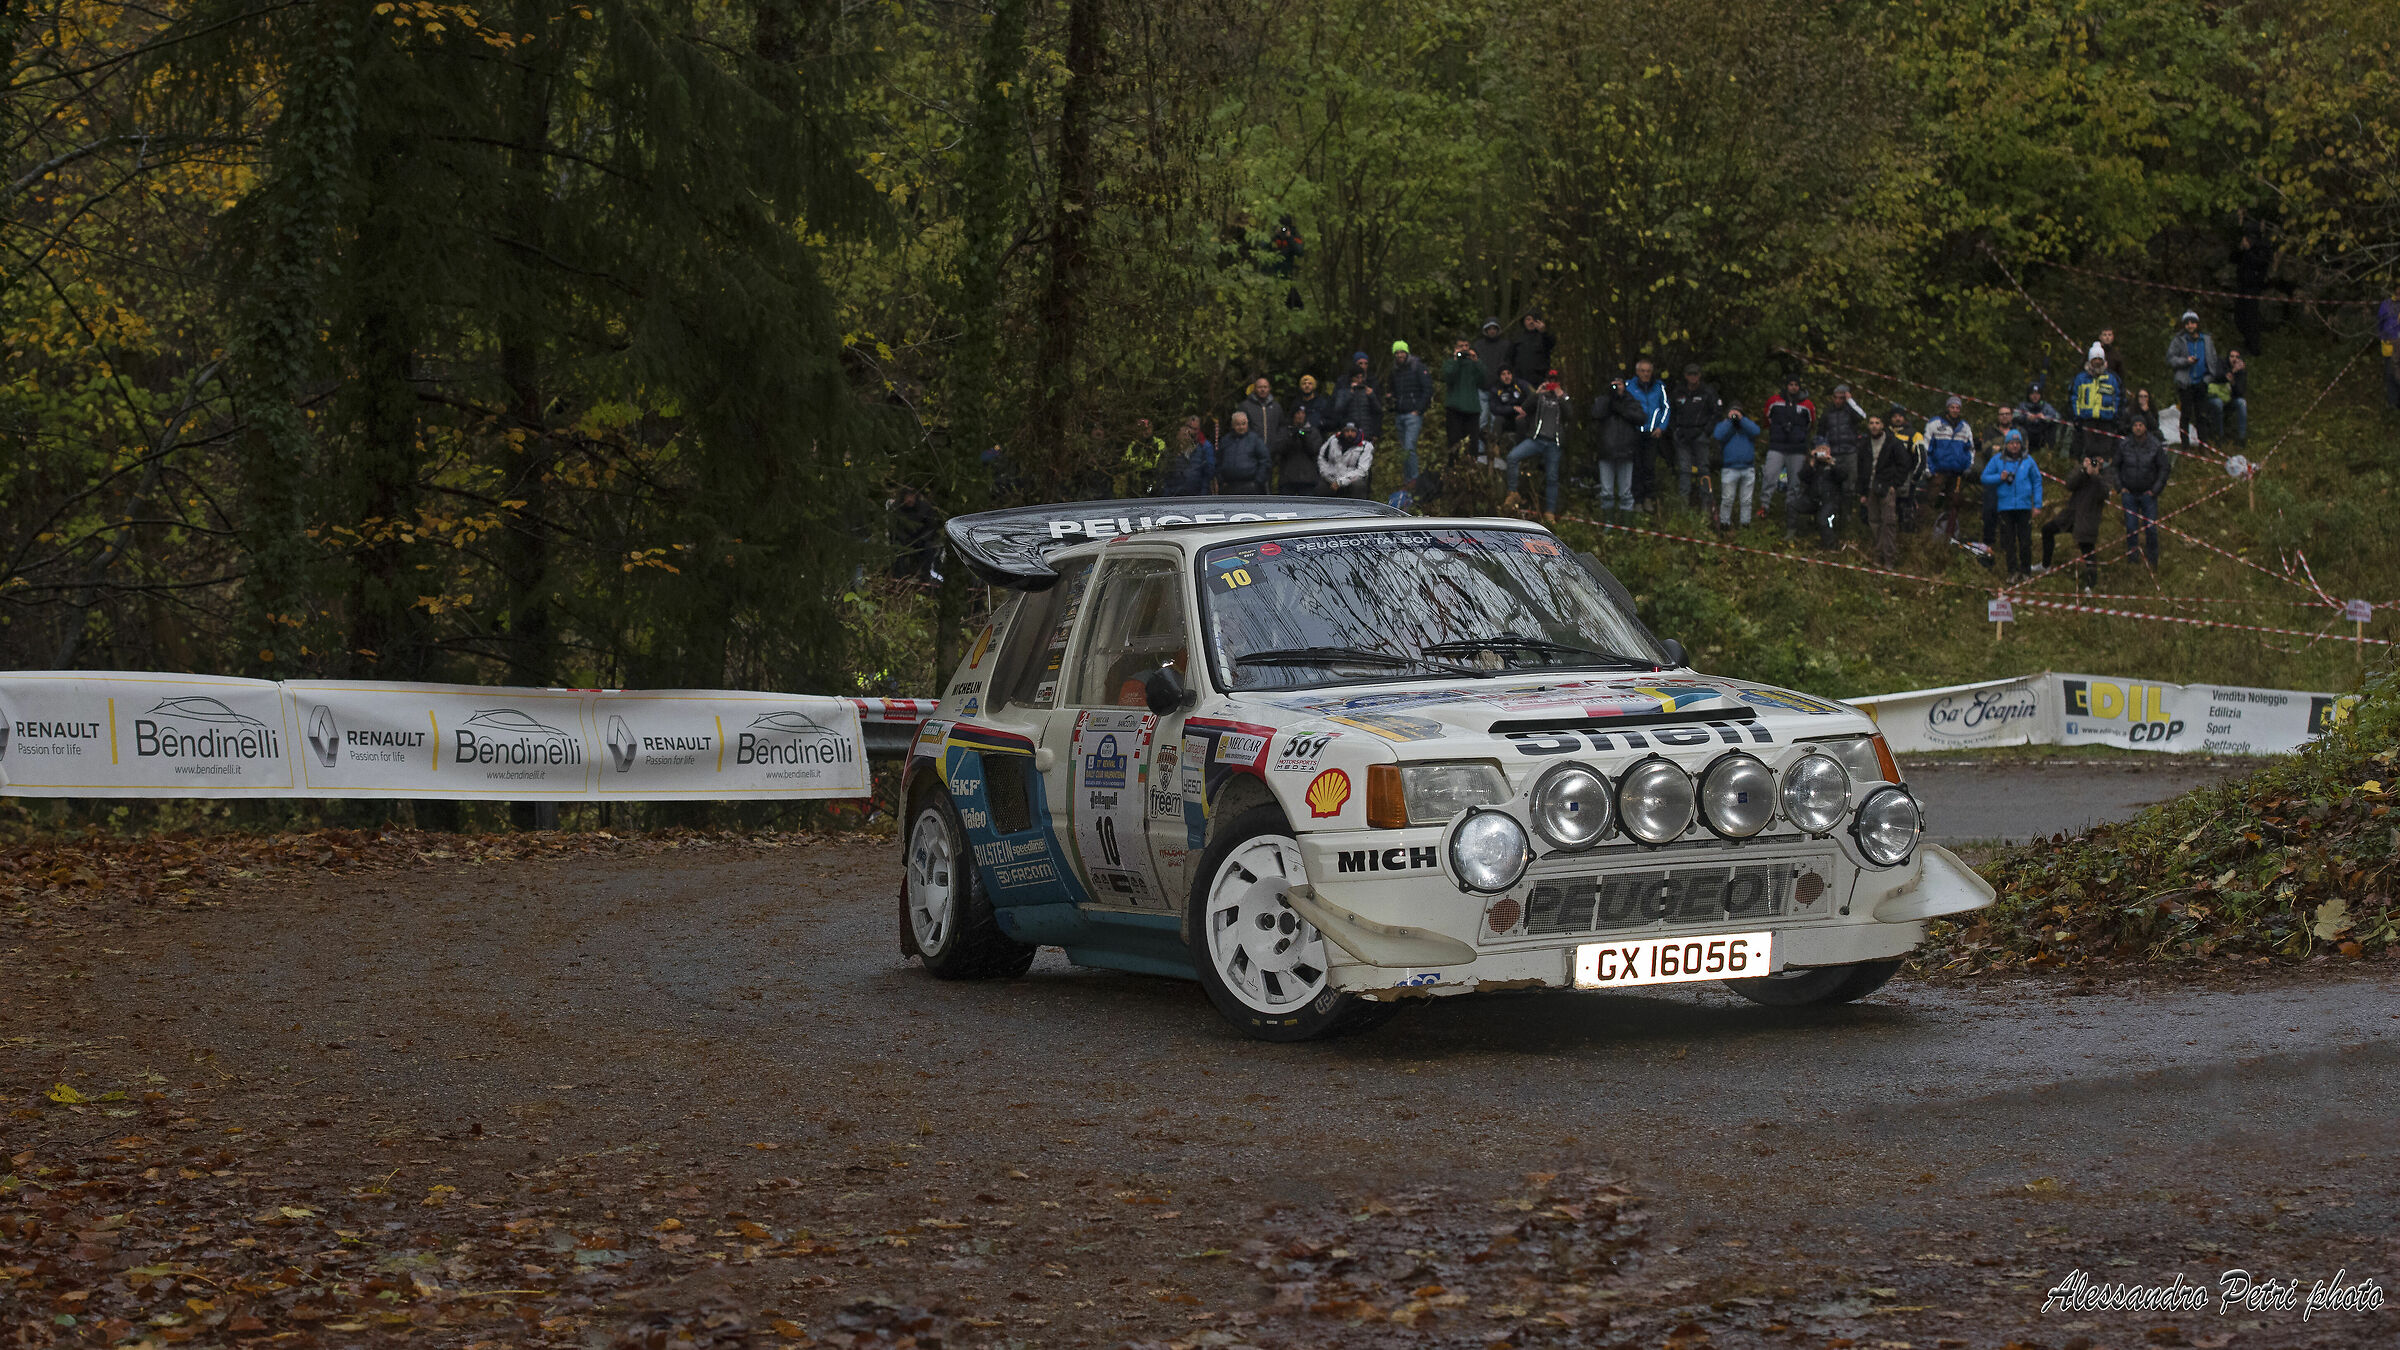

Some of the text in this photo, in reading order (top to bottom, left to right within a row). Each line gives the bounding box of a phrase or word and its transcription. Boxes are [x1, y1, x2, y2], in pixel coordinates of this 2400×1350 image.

[1296, 538, 1369, 552] PEUGEOT
[1220, 568, 1252, 589] 10
[951, 681, 982, 697] MICHELIN
[2063, 680, 2170, 723] EDIL
[2212, 690, 2288, 706] Vendita Noleggio
[2209, 706, 2242, 718] Edilizia
[16, 721, 100, 739] RENAULT
[2129, 720, 2184, 742] CDP
[2206, 722, 2231, 734] Sport
[135, 719, 280, 759] Bendinelli
[347, 730, 425, 748] RENAULT
[455, 729, 581, 765] Bendinelli
[643, 736, 712, 751] RENAULT
[1243, 739, 1262, 753] CAR
[1282, 736, 1333, 759] 569
[2203, 738, 2251, 751] Spettacolo
[18, 744, 81, 755] Passion for life
[737, 731, 852, 765] Bendinelli
[350, 751, 405, 763] Passion for life
[645, 755, 695, 765] Passion for life
[174, 764, 242, 776] www.bendinelli.it
[486, 769, 545, 780] www.bendinelli.it
[766, 769, 821, 779] www.bendinelli.it
[951, 779, 979, 796] SKF
[1150, 785, 1182, 818] freem
[961, 808, 987, 829] Valeo
[1096, 816, 1120, 866] 10
[974, 840, 1015, 867] BILSTEIN
[1523, 871, 1791, 929] PEUGEOT
[1598, 938, 1749, 981] GX 16056
